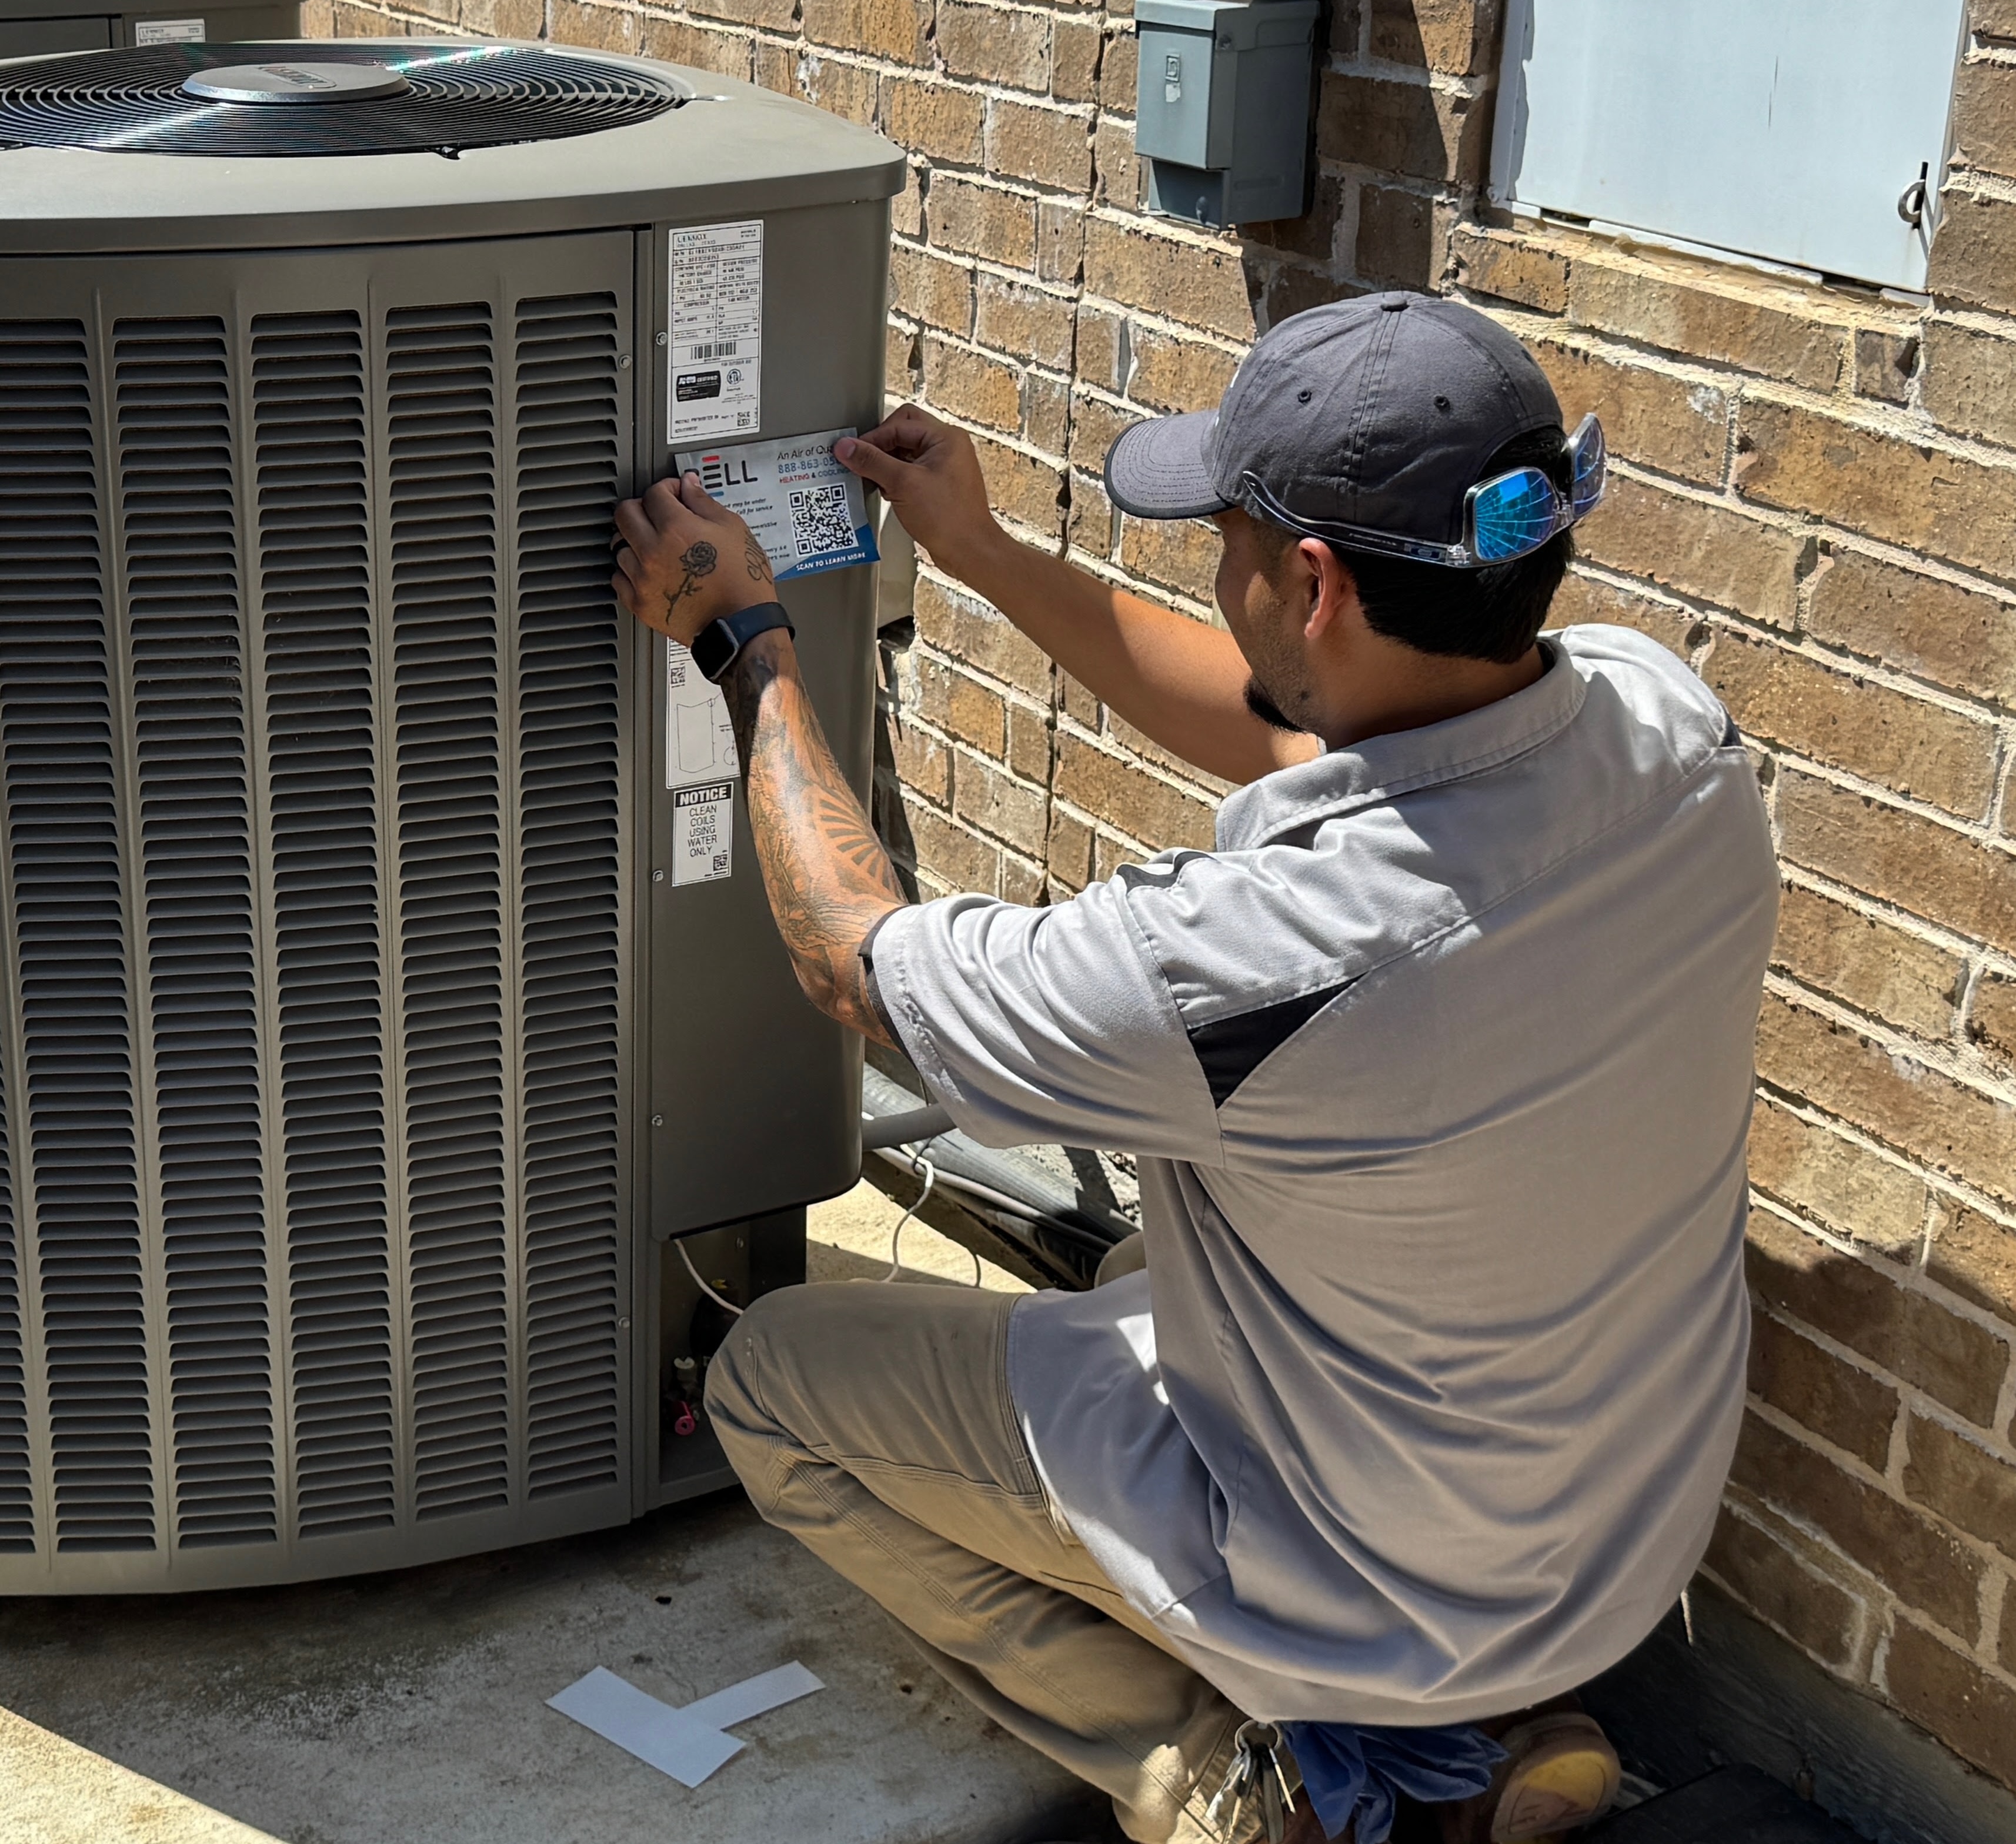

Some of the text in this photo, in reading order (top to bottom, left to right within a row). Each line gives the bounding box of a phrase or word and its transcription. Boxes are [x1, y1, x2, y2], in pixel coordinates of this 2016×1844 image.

[777, 452, 789, 460] An
[791, 449, 803, 459] Air
[806, 446, 814, 456] of
[780, 473, 810, 483] HEATING
[796, 562, 814, 571] SCAN
[825, 556, 846, 565] LEARN
[679, 787, 727, 806] NOTICE
[689, 804, 717, 817] CLEAN
[690, 815, 716, 827] COILS
[689, 825, 716, 837] USING
[687, 835, 717, 847] WATER
[689, 846, 713, 857] ONLY
